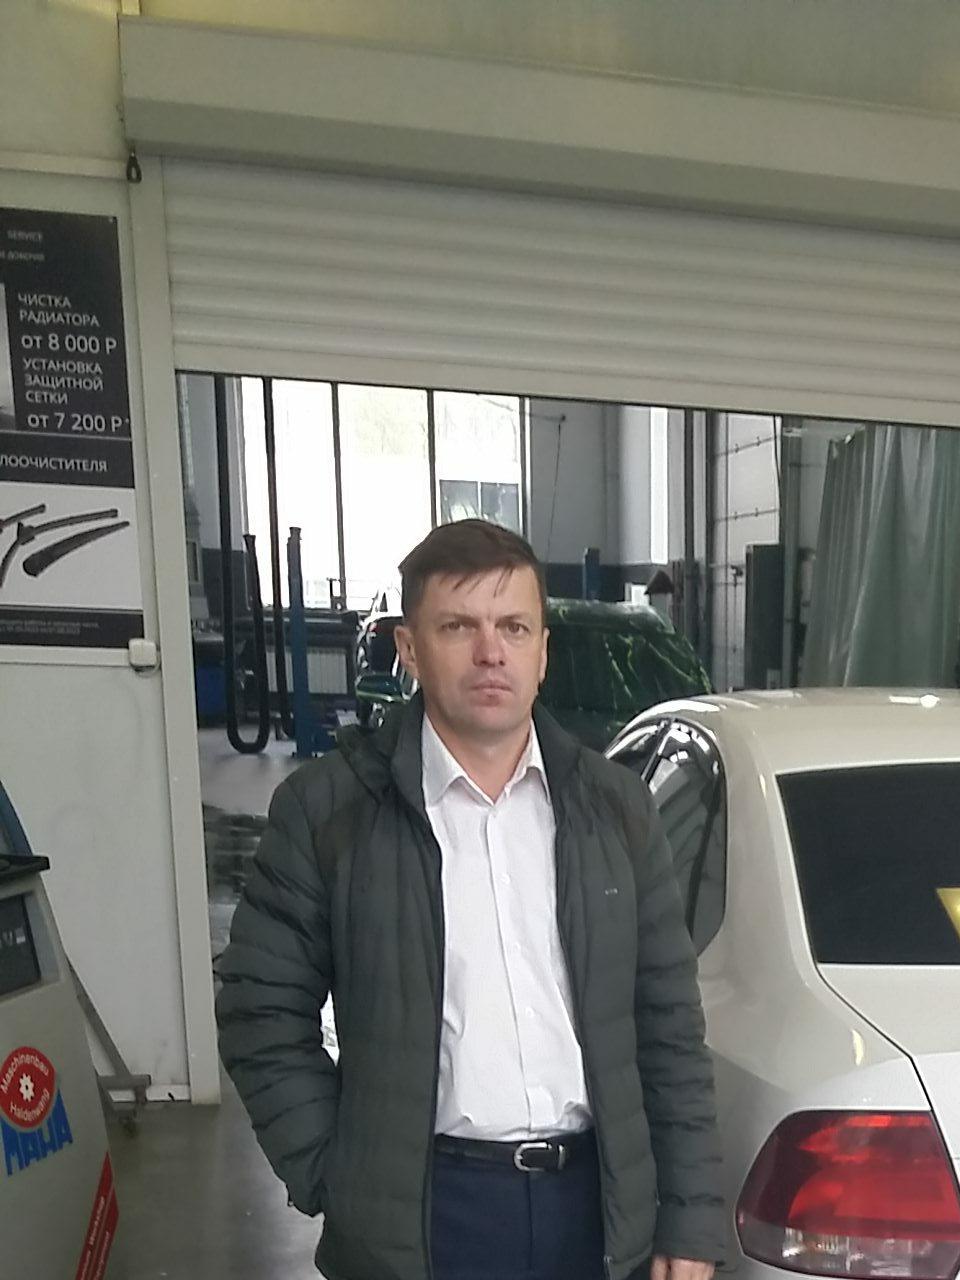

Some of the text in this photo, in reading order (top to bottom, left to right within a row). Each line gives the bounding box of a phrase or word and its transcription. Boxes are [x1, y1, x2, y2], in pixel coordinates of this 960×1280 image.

[18, 293, 72, 309] ЧИСТКА
[20, 309, 101, 328] РАДИАТОРА
[21, 335, 42, 349] от
[48, 333, 60, 351] 8
[64, 334, 101, 354] 000
[23, 358, 103, 375] УСТАНОВКА
[25, 373, 104, 392] ЗАЩИТНОЙ
[25, 390, 69, 405] СЕТКИ
[27, 413, 49, 428] от
[54, 412, 66, 430] 7
[71, 413, 107, 433] 200
